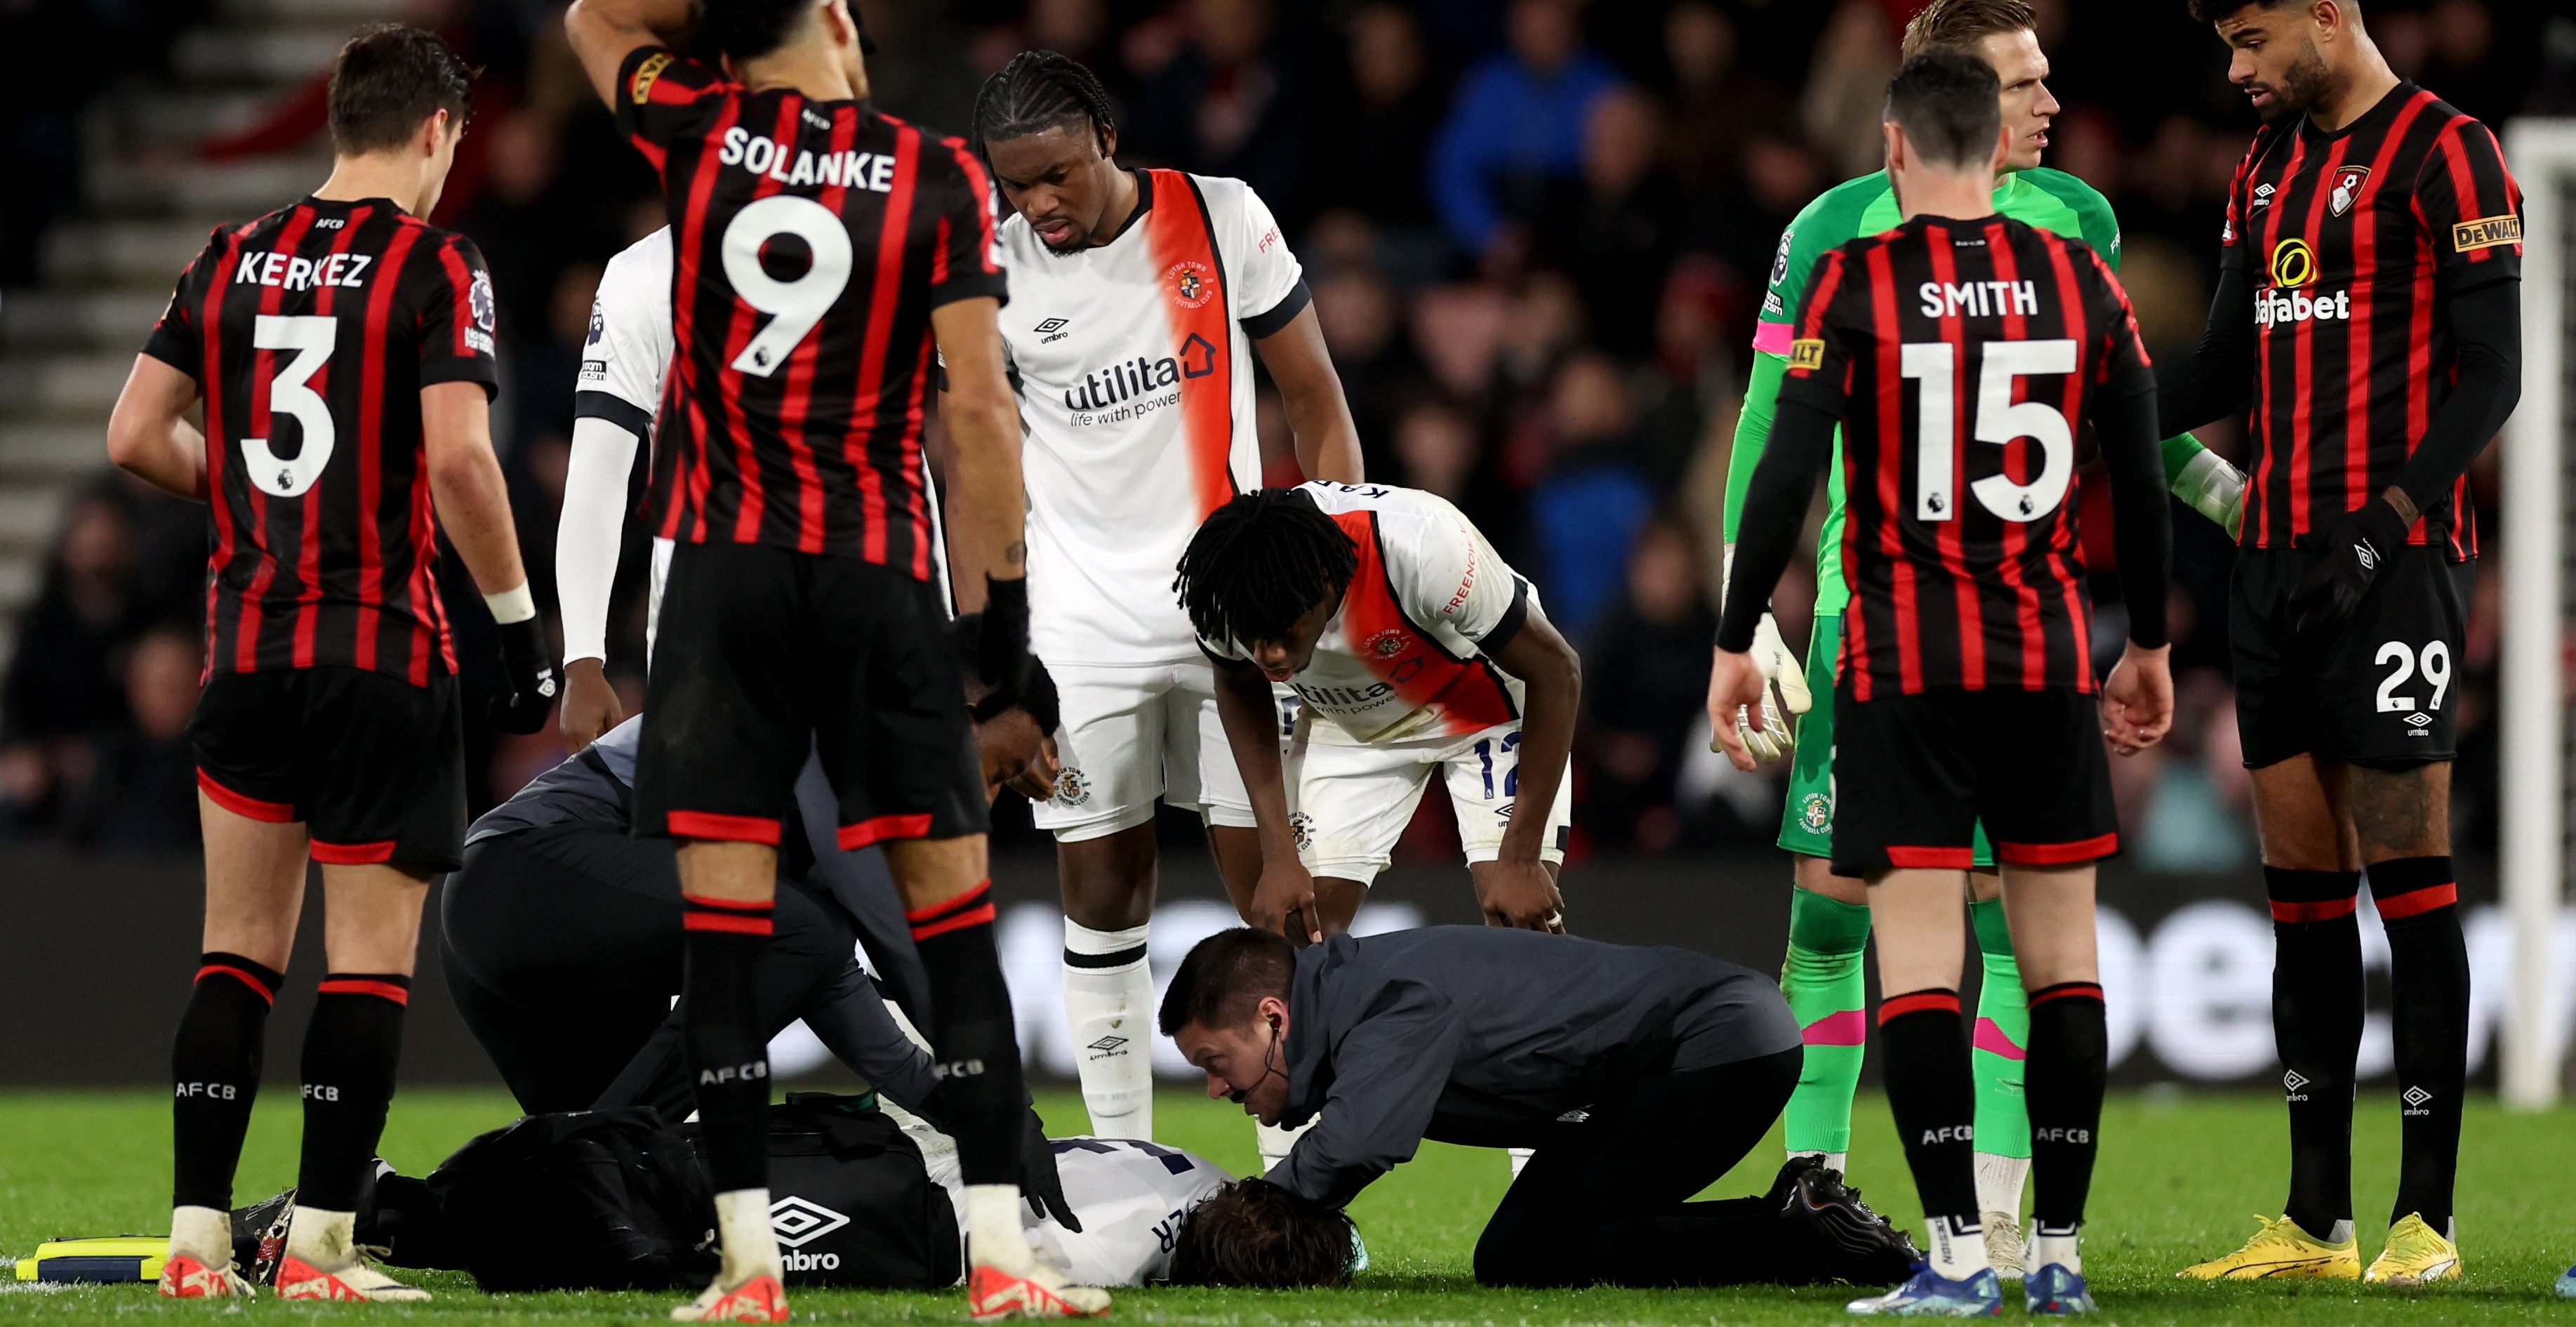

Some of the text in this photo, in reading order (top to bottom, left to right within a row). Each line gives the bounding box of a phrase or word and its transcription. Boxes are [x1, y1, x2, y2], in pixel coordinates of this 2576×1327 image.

[719, 126, 896, 192] SOLANKE
[314, 218, 345, 229] AFCB
[236, 251, 372, 291] KERKEZ
[1187, 261, 1207, 272] TOWN
[722, 194, 853, 377] 9
[1920, 281, 2038, 317] SMITH
[1041, 331, 1068, 344] umbro
[1065, 357, 1180, 410] utilita
[240, 315, 337, 497] 3
[1070, 391, 1181, 427] life with power
[1900, 339, 2076, 522] 15
[2375, 640, 2450, 713] 29
[2408, 728, 2429, 737] umbro
[1802, 793, 1818, 804] LUTON
[1798, 818, 1820, 834] FOOTBALL
[1089, 1050, 1128, 1060] umbro
[700, 1059, 766, 1085] AFCB
[932, 1059, 985, 1081] FCB
[176, 1081, 236, 1101] AFCB
[2404, 1107, 2429, 1116] umbro
[1922, 1125, 1973, 1145] AFCB
[2037, 1127, 2089, 1144] AFCB
